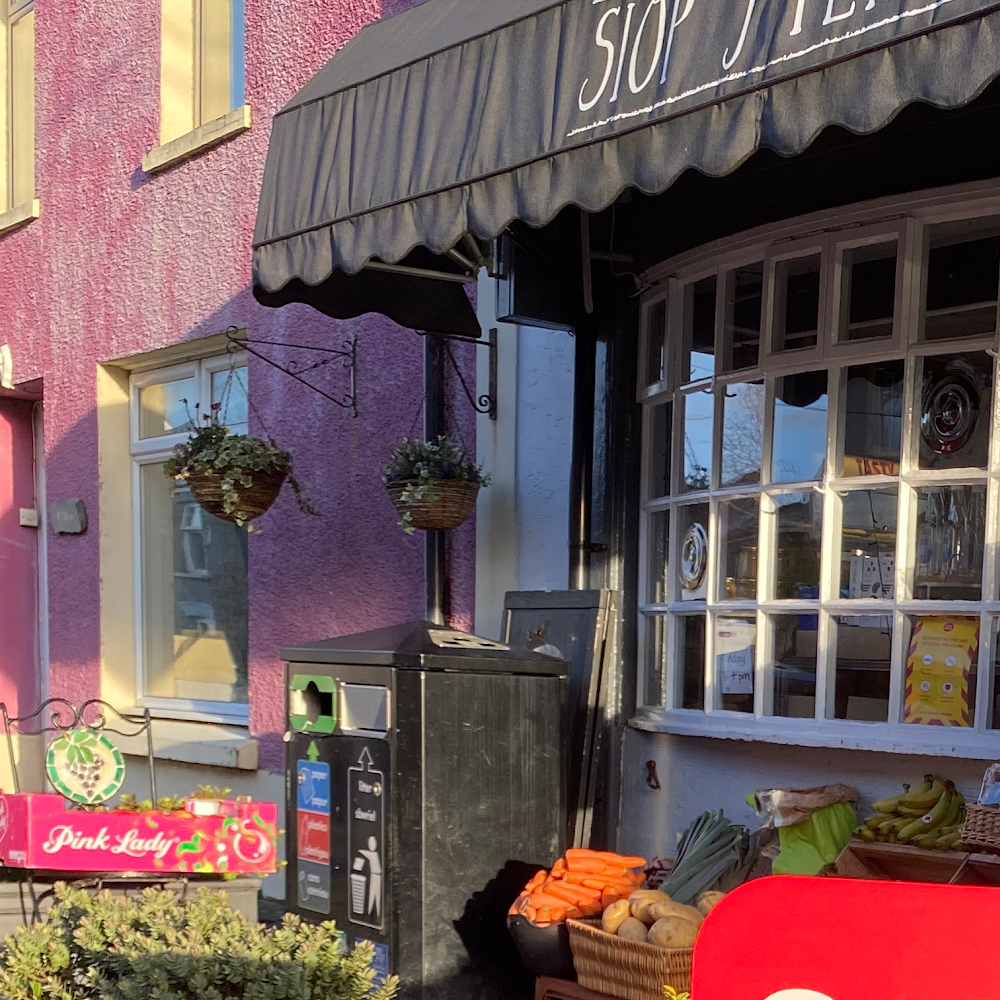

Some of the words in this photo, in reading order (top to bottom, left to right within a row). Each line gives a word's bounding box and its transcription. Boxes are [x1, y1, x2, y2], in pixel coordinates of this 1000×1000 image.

[578, 0, 695, 111] SIOP
[43, 825, 110, 854] Pink
[110, 828, 173, 859] Lady
